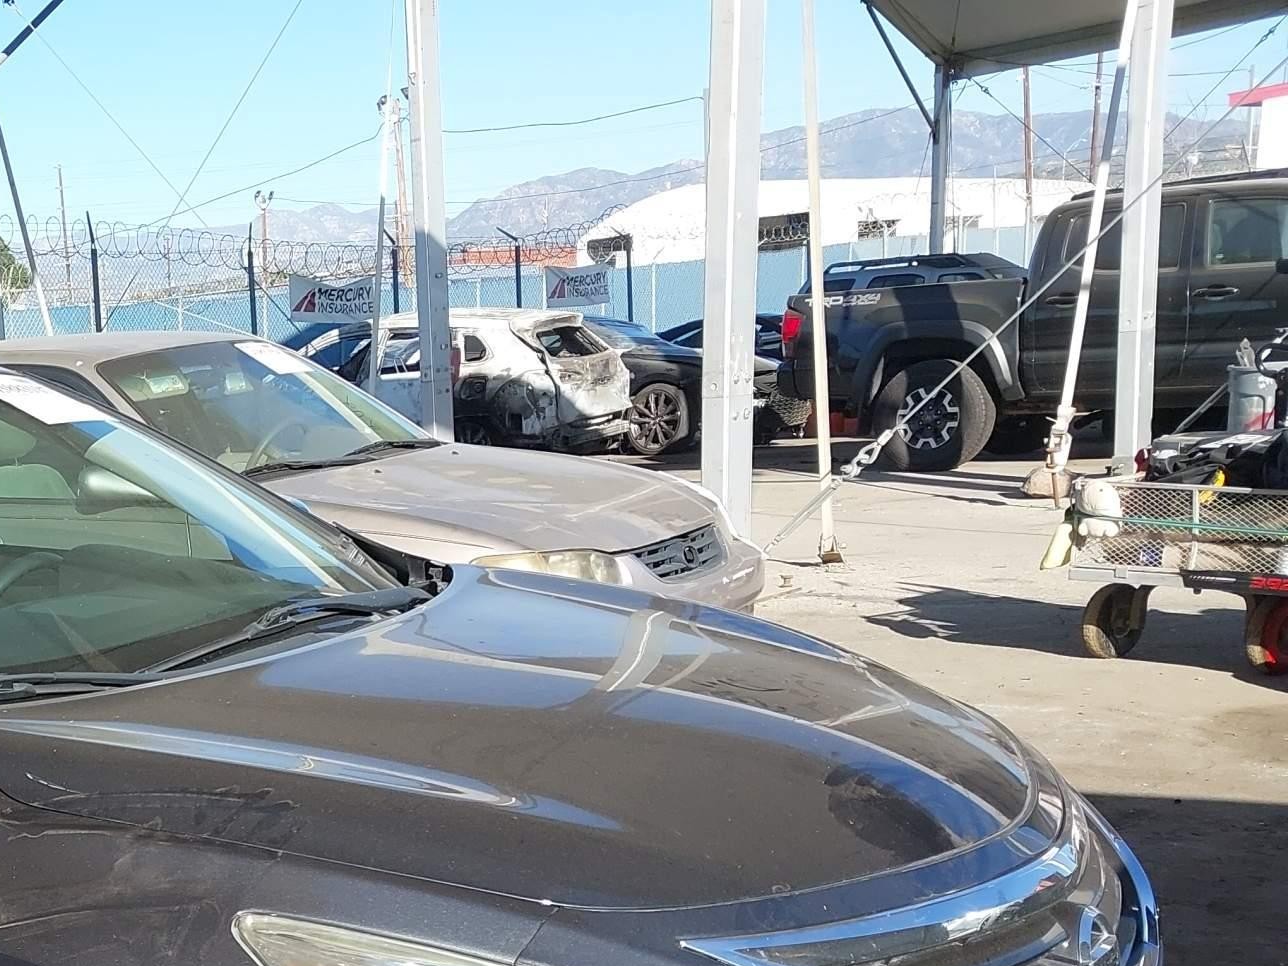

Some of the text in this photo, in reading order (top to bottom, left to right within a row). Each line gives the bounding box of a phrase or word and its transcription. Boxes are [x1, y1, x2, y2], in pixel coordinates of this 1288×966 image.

[566, 271, 607, 287] MERCURY
[317, 287, 372, 302] MERCURY
[567, 285, 609, 297] INSURANCE
[317, 301, 373, 314] INSURANCE
